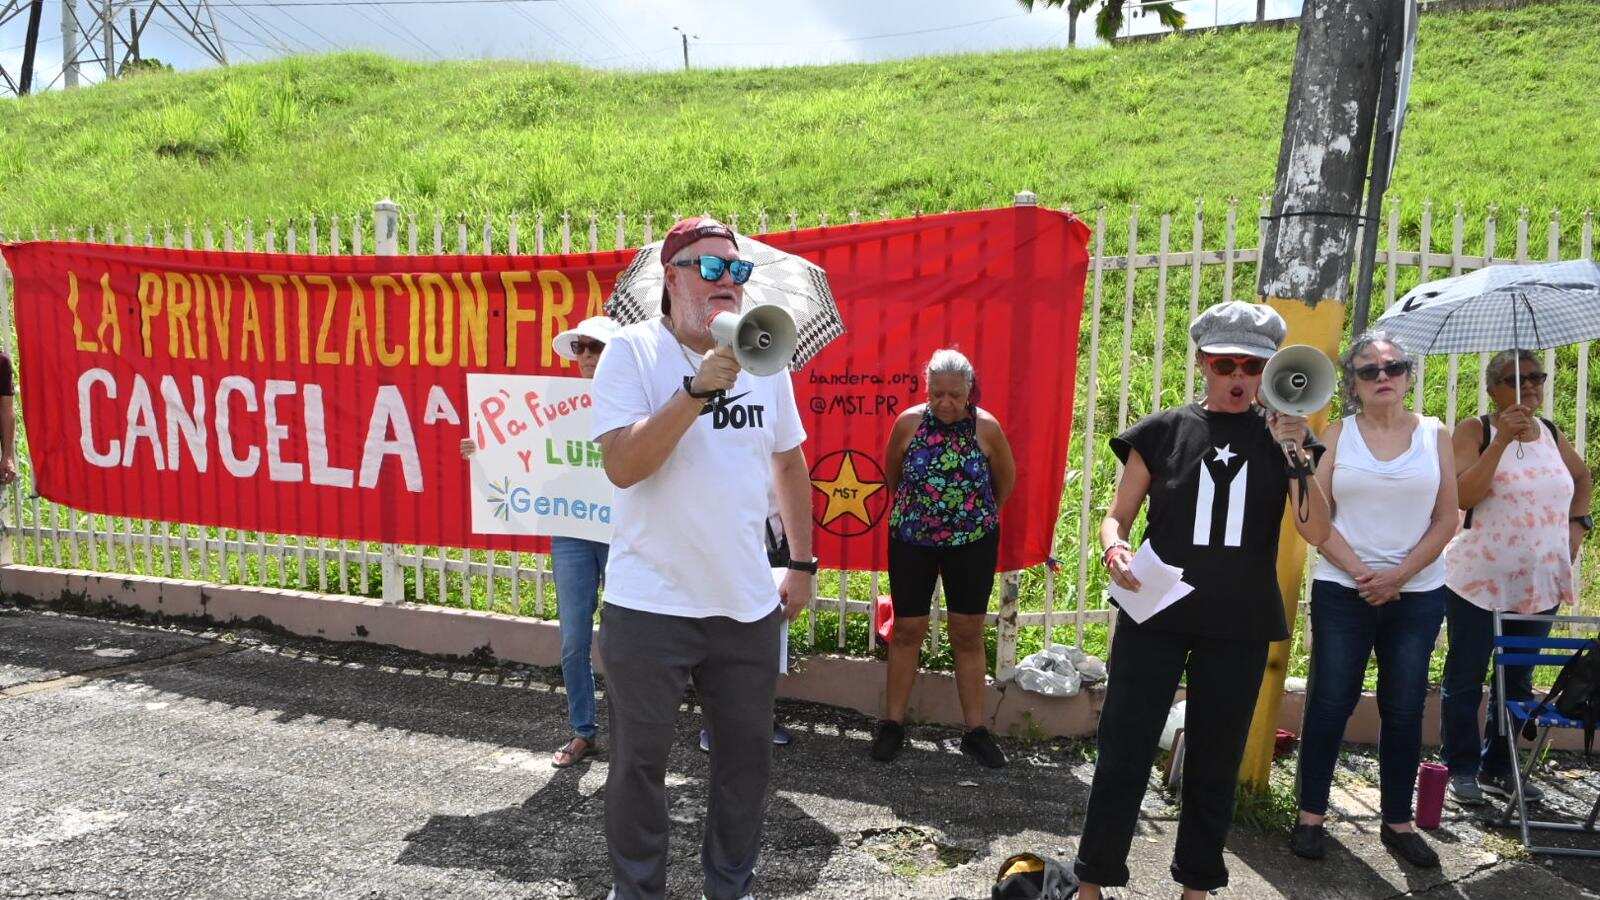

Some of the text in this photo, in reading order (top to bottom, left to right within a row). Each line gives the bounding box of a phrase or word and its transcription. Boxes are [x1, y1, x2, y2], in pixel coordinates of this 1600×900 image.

[67, 270, 626, 368] LA PRIVATIZACION FRA
[810, 369, 919, 393] bandera.org
[809, 395, 899, 416] @MST_PR
[78, 367, 460, 492] CANCELA A
[832, 488, 859, 499] MST
